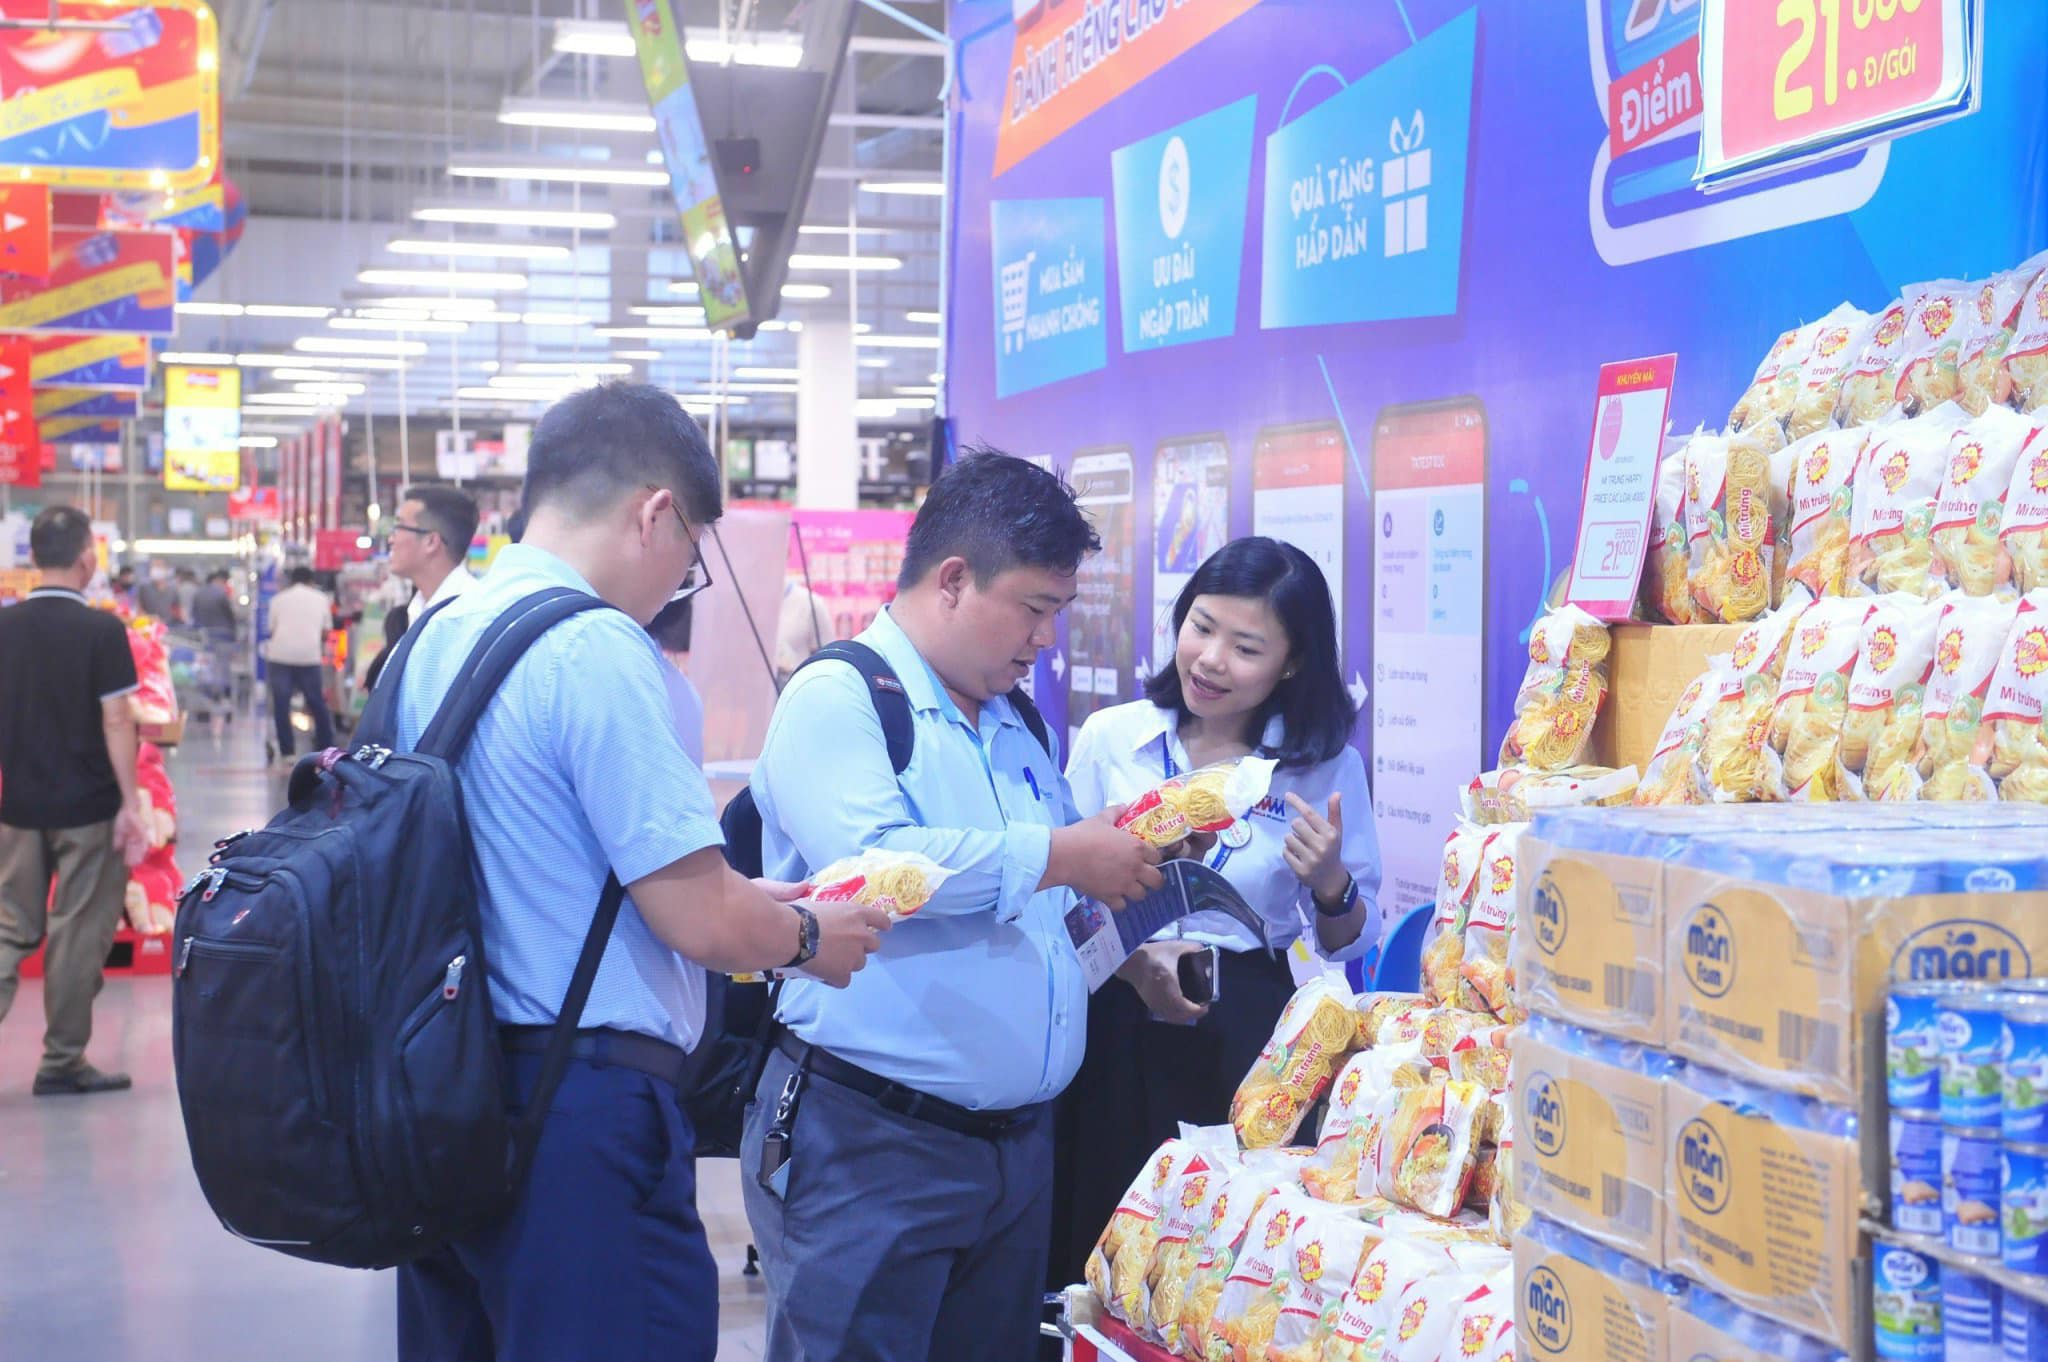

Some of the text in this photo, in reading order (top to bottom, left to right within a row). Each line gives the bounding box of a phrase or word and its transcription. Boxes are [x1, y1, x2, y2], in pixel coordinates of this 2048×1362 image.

[1863, 37, 1917, 88] Đ/GÓI
[1619, 58, 1692, 142] Điểm
[1290, 162, 1325, 220] QUÀ
[1295, 212, 1329, 270] HẤP
[2000, 685, 2015, 702] Mì
[1342, 1311, 1373, 1337] trứng
